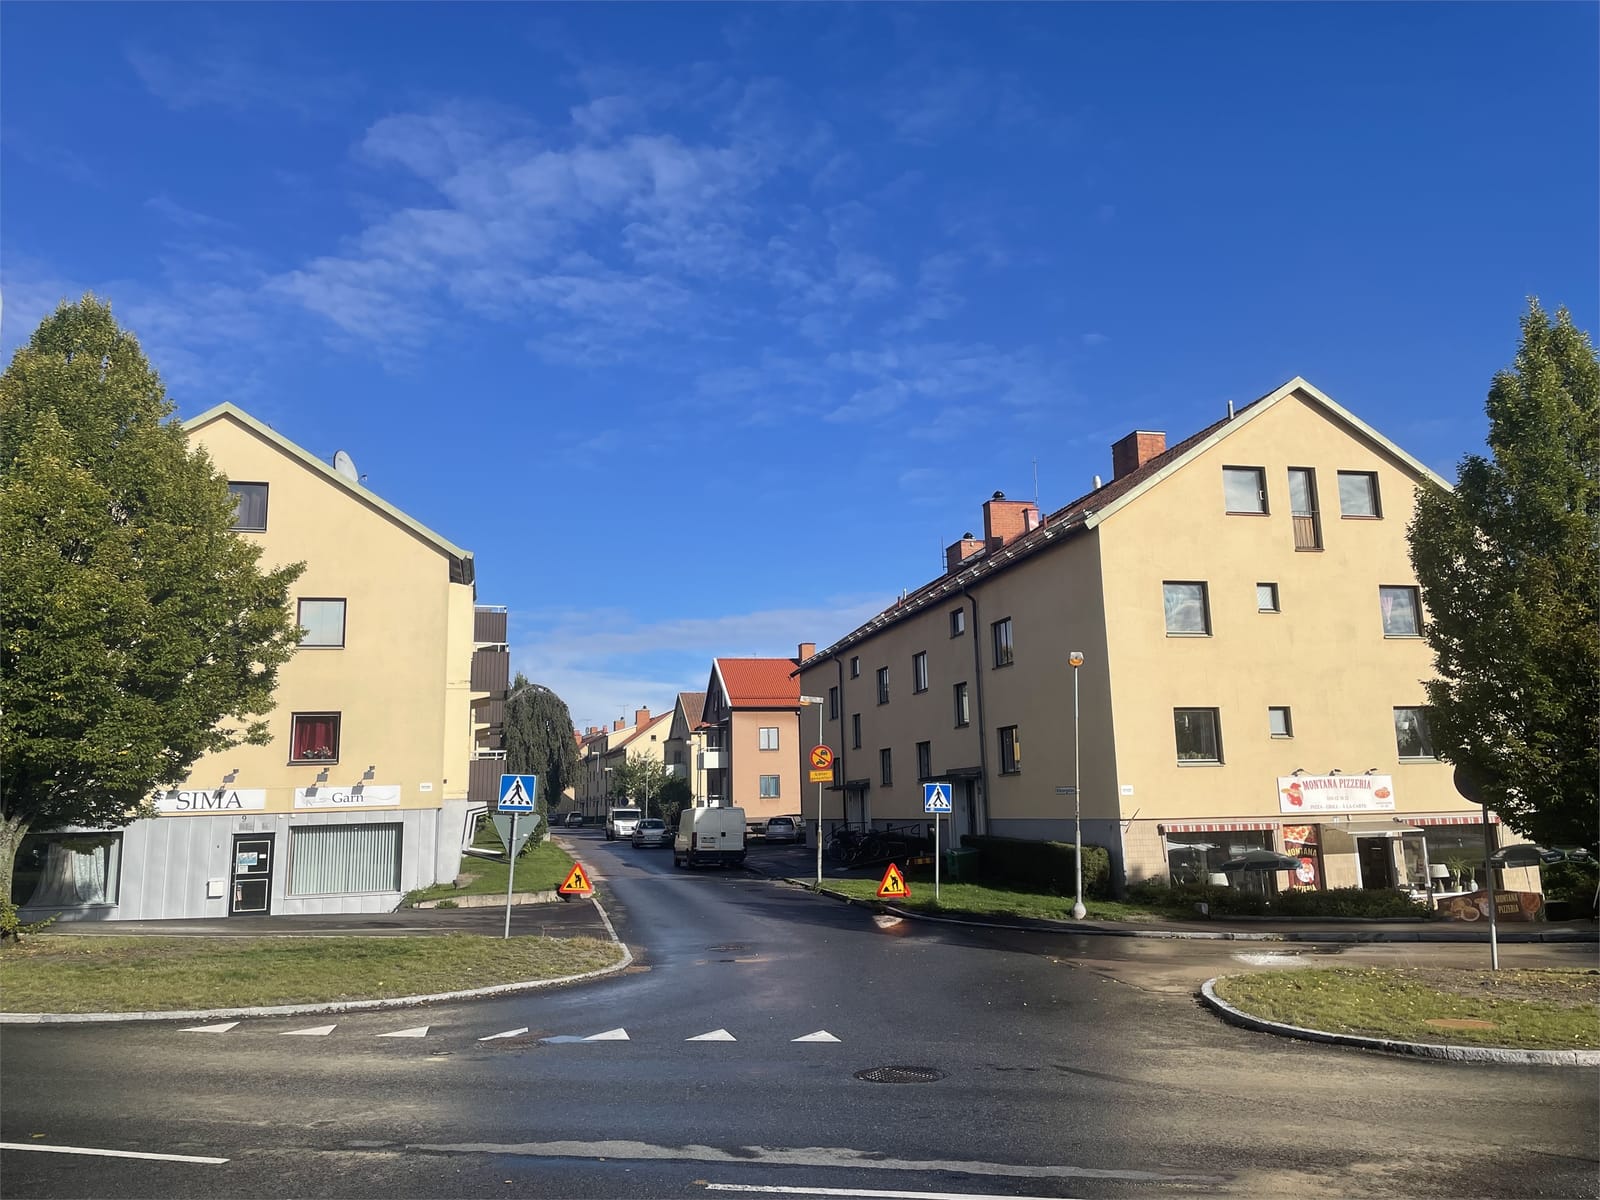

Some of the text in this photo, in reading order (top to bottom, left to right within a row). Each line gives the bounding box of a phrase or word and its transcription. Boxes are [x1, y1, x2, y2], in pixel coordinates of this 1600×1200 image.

[1302, 779, 1371, 790] MONTANA PIZZERIA
[176, 791, 243, 810] SIMA
[332, 792, 364, 803] Garn
[242, 815, 247, 823] 9
[1286, 847, 1317, 857] MONTANA
[1495, 893, 1518, 902] MONTANA
[1497, 904, 1520, 913] PIZZERIA
